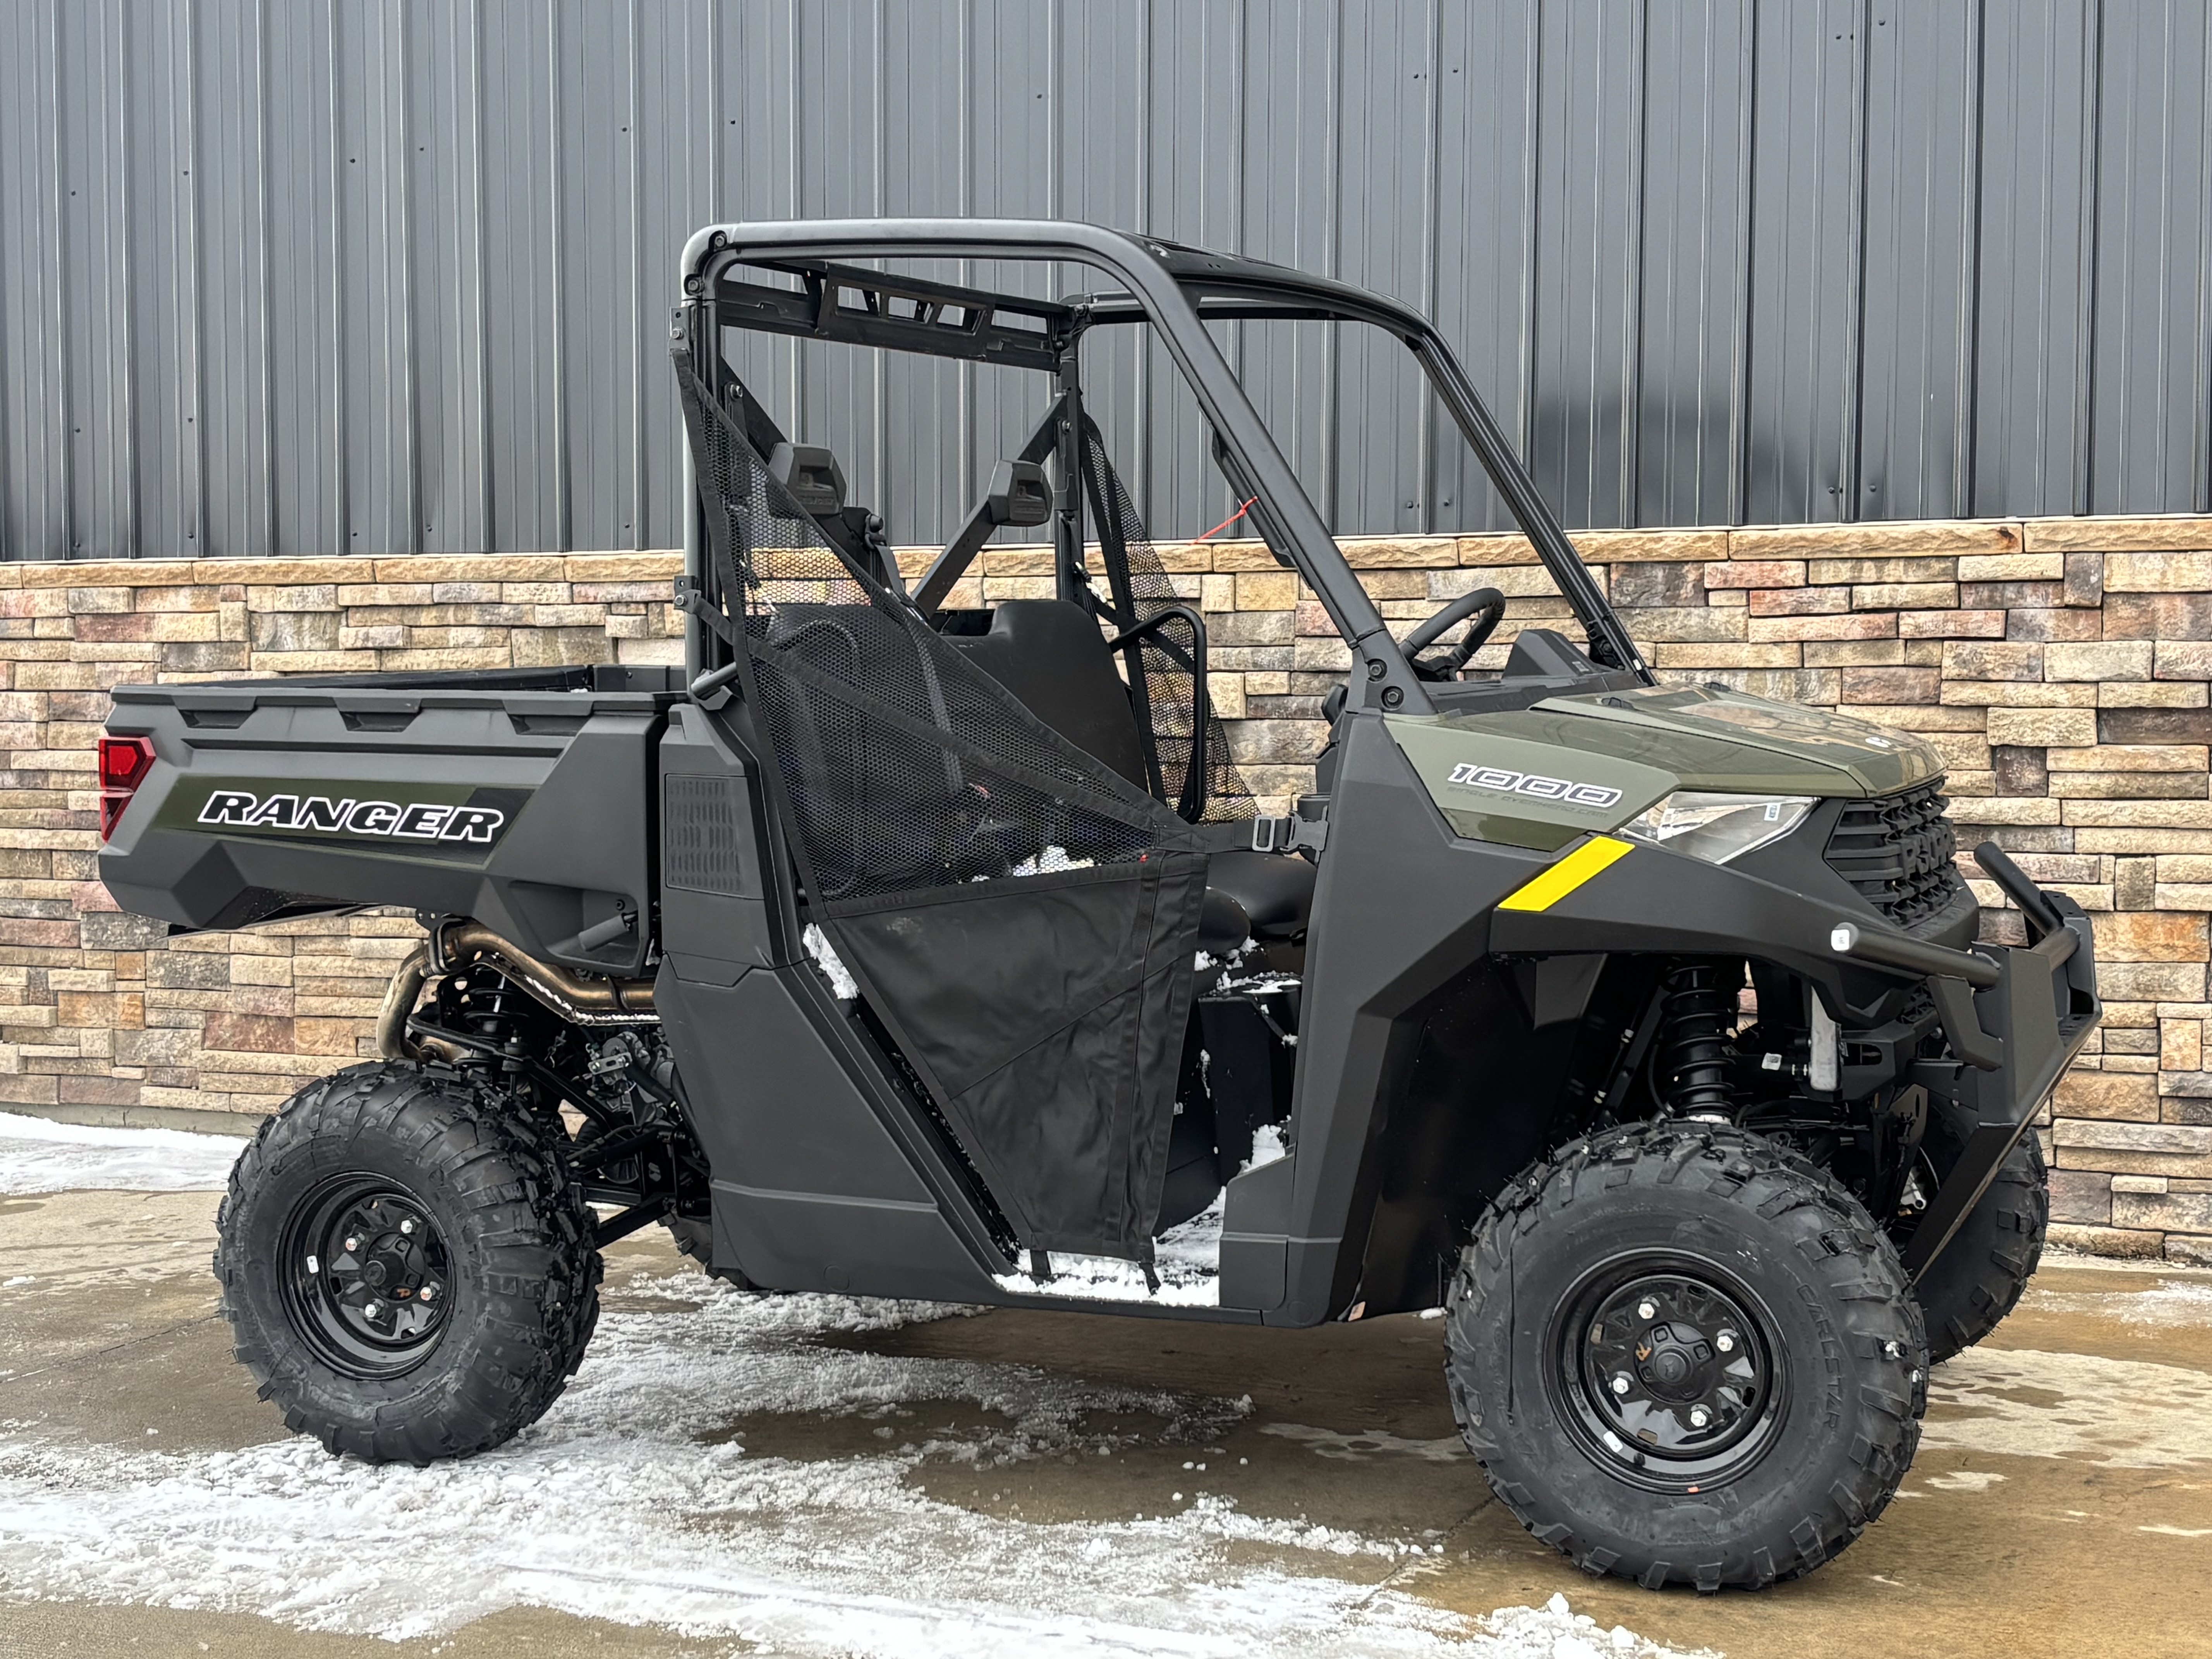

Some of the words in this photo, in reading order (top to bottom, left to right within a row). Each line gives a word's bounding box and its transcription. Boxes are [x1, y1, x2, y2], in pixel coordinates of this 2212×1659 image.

[1447, 786, 1497, 799] SINGLE
[1448, 763, 1623, 807] 1000
[197, 790, 505, 842] RANGER
[1901, 824, 1956, 878] POLAR
[1797, 1283, 1842, 1428] CARLSTAR
